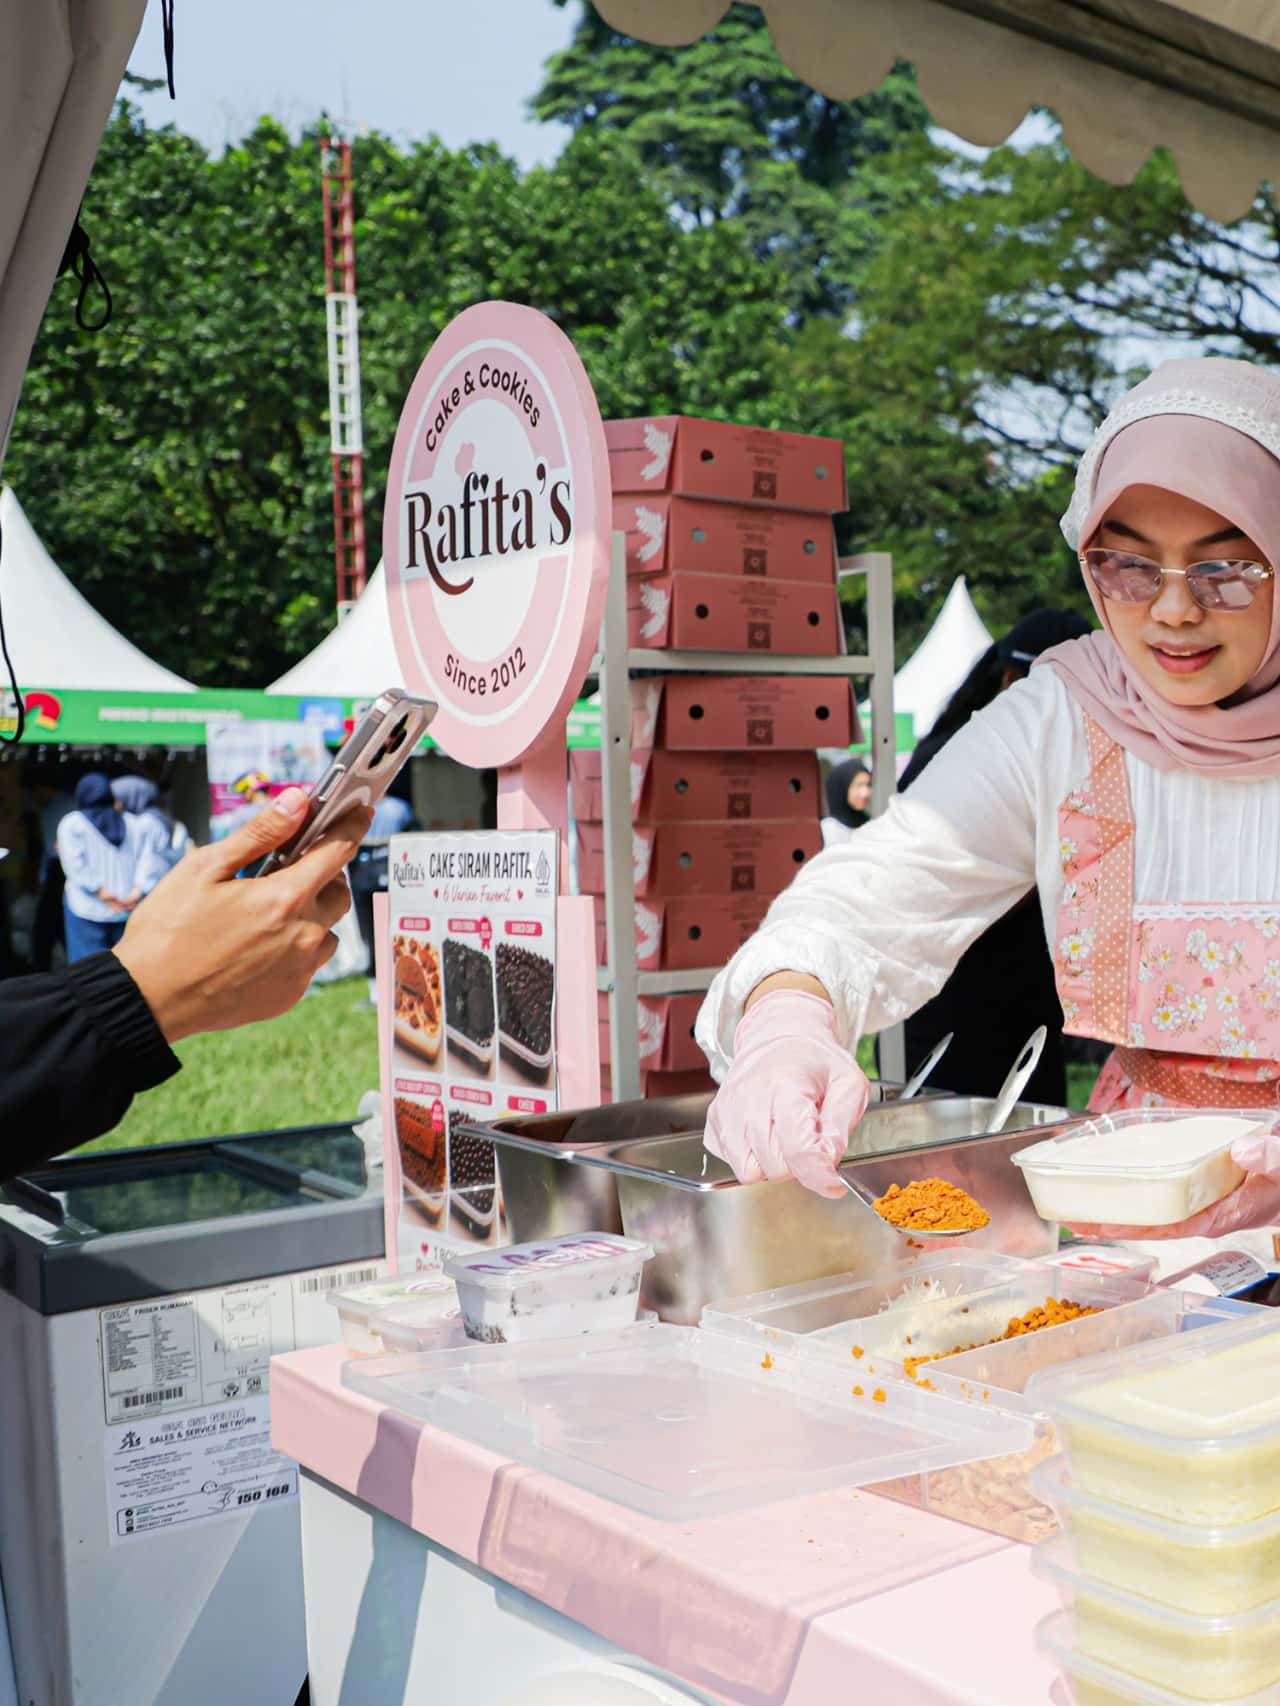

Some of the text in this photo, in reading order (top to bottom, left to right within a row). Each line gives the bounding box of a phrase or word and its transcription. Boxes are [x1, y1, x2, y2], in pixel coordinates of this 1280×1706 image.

[425, 363, 541, 452] Cake & Cookies
[405, 463, 572, 596] Rafita's
[445, 646, 526, 695] Since 2012
[393, 863, 425, 888] Rafita's
[429, 852, 532, 879] CAKE SIRAM RAFITA
[480, 884, 511, 904] Favorit
